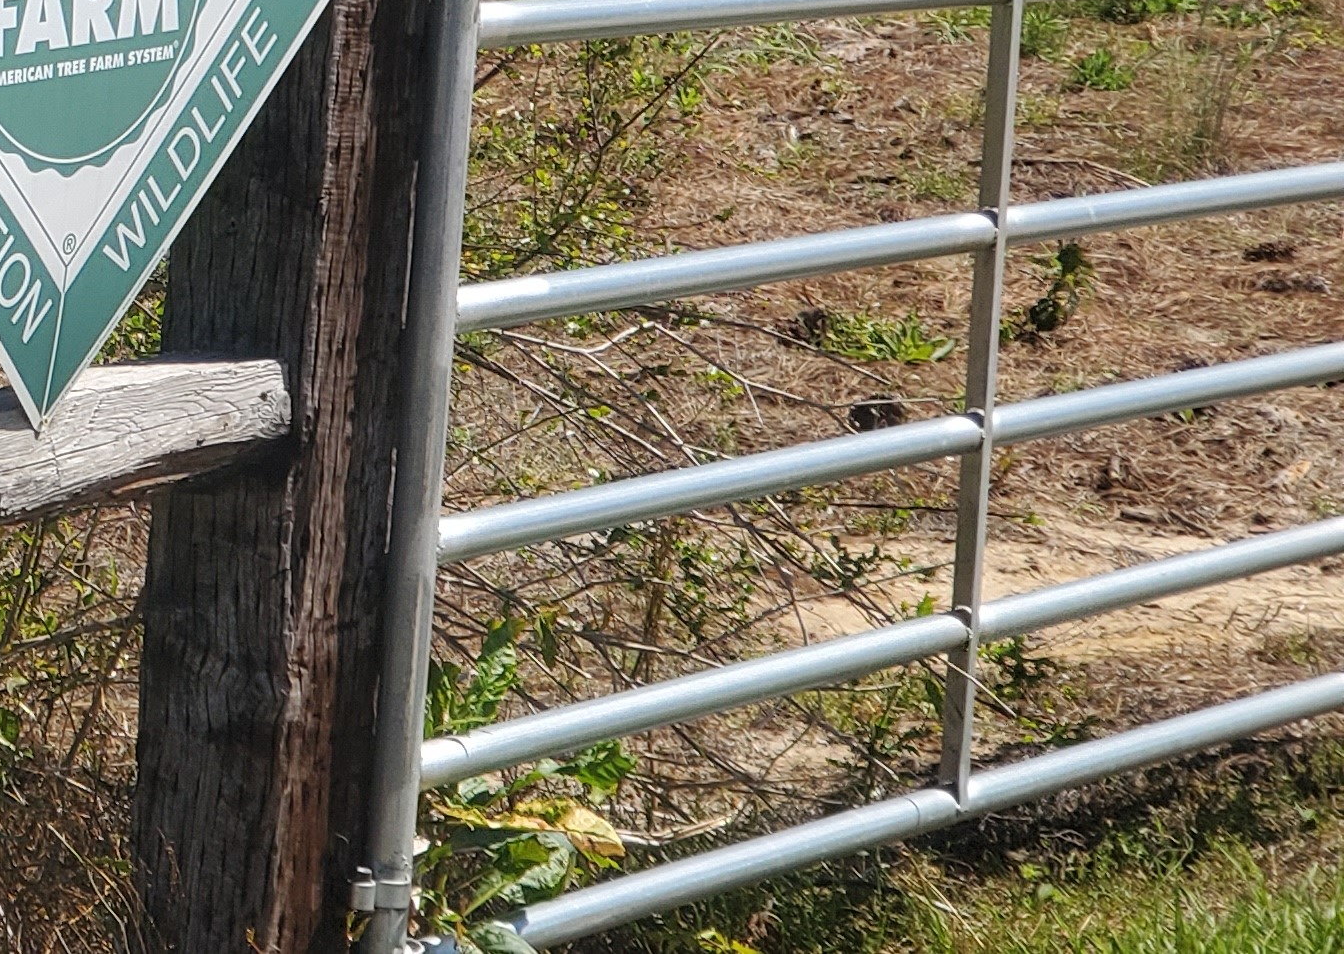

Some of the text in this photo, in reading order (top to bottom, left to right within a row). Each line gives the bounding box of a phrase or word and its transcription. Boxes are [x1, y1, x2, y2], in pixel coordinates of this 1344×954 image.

[56, 57, 87, 78] TREE
[89, 52, 125, 74] FARM
[101, 6, 280, 275] WILDLIFE
